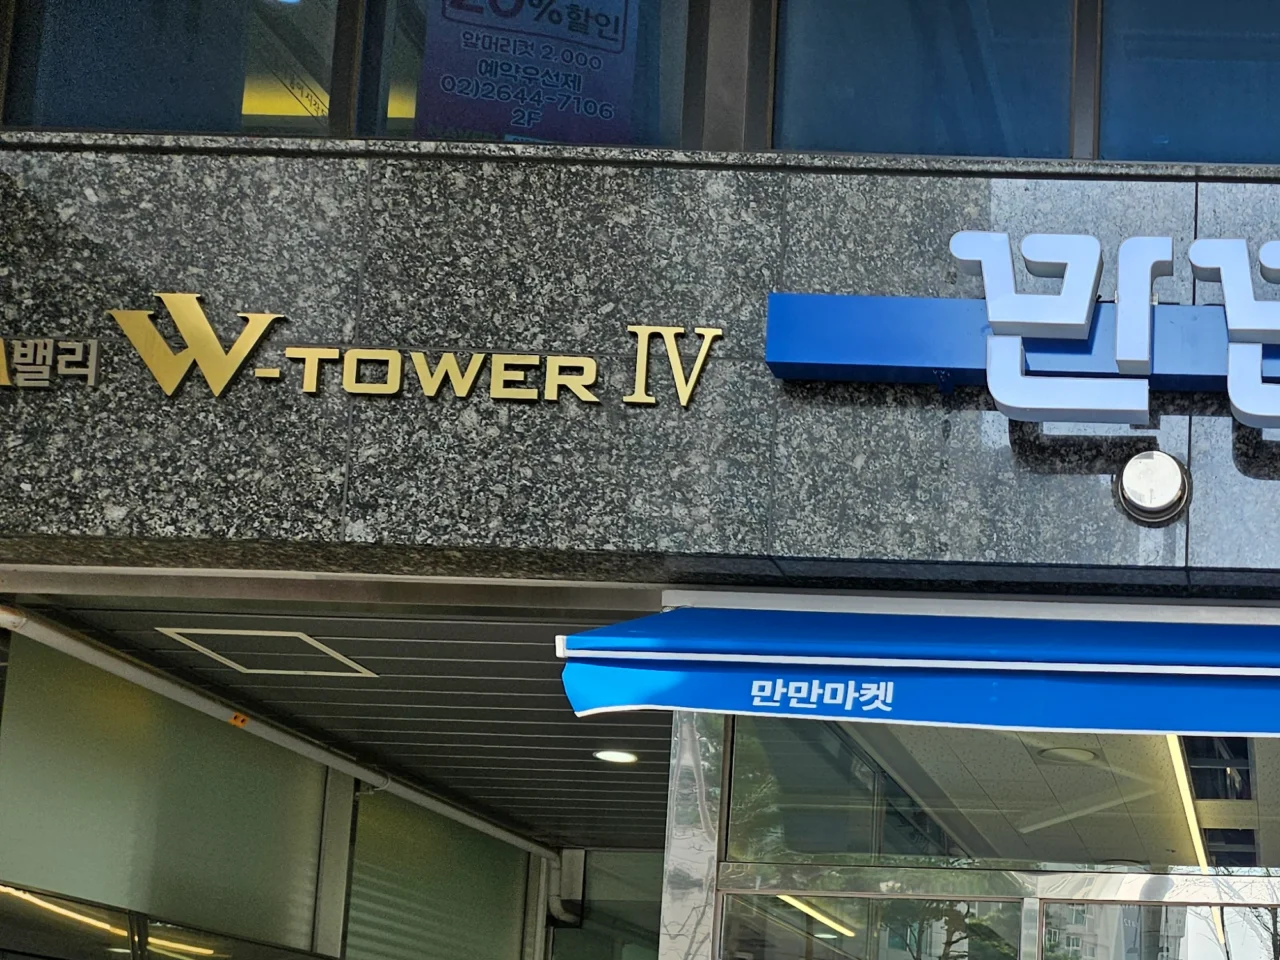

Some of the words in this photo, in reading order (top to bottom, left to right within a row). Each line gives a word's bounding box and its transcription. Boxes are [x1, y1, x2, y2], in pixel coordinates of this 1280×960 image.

[449, 0, 620, 43] %할인
[462, 30, 535, 58] 앞머리컷
[540, 43, 603, 71] 2,000
[478, 58, 582, 93] 예약우선제
[440, 74, 614, 120] 02)2644-7106
[511, 108, 543, 128] 2F
[0, 337, 98, 387] 밸리
[108, 292, 602, 402] W-TOWER
[622, 325, 723, 406] IV
[751, 679, 894, 712] 만만마켓
